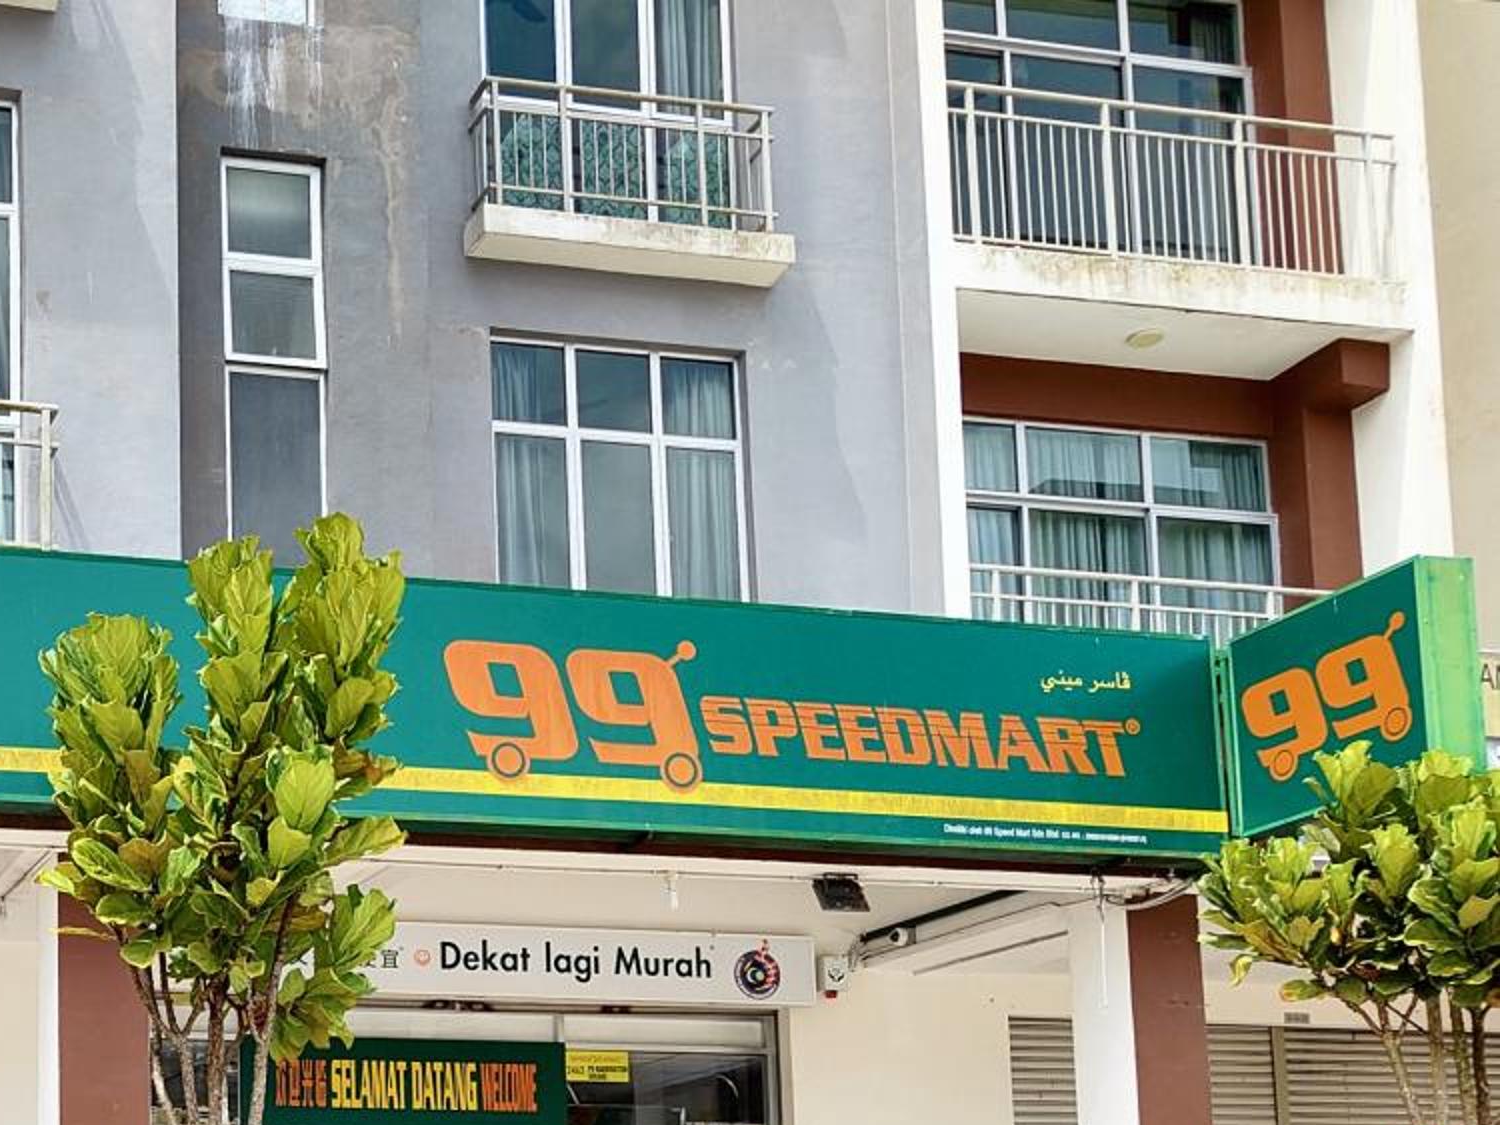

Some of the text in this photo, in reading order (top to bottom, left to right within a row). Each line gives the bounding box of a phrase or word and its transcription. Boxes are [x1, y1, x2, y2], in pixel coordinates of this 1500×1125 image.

[443, 639, 703, 793] 99
[1240, 611, 1413, 782] 99
[440, 940, 711, 983] Dekat lagi Murah
[331, 1059, 537, 1112] SELAMAT DATANG WELCOME
